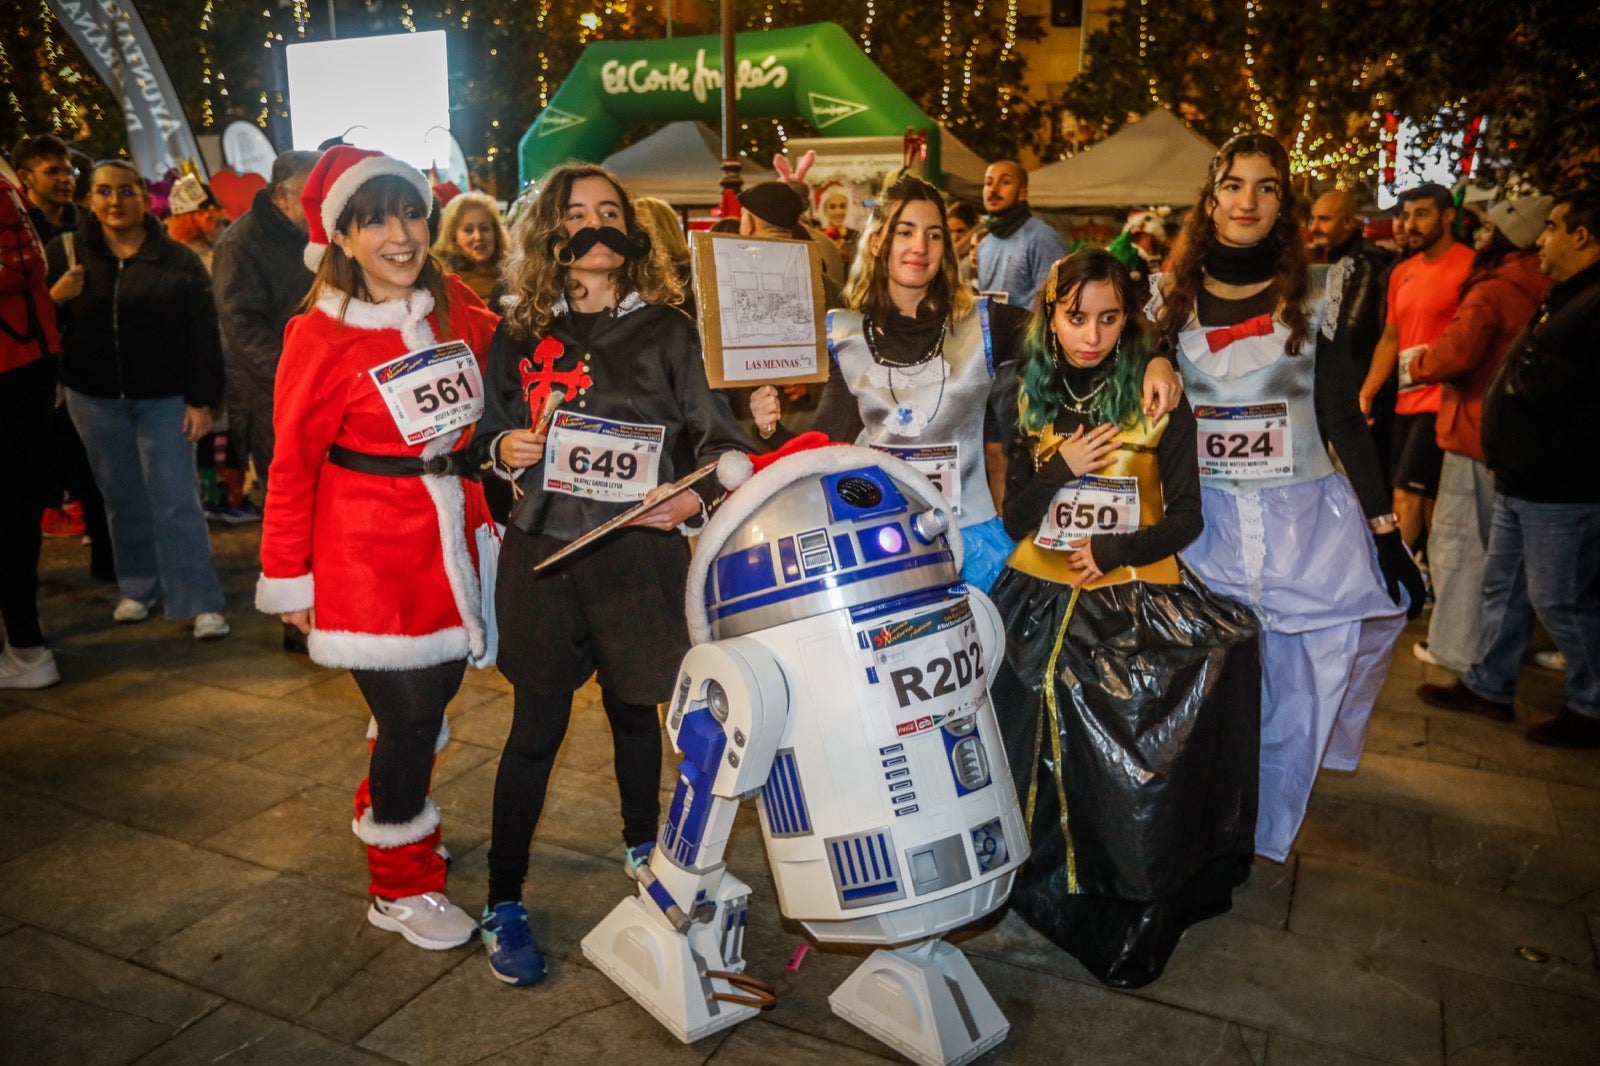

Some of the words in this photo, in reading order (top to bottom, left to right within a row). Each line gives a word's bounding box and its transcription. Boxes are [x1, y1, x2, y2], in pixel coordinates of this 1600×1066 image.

[601, 60, 629, 95] El
[627, 59, 691, 95] Corte
[692, 48, 789, 104] Inlés
[745, 360, 761, 371] LAS
[763, 358, 799, 369] MENINAS
[413, 372, 474, 414] 561
[1206, 432, 1273, 458] 624
[568, 446, 638, 481] 649
[1056, 502, 1119, 530] 650
[890, 641, 985, 708] R2D2
